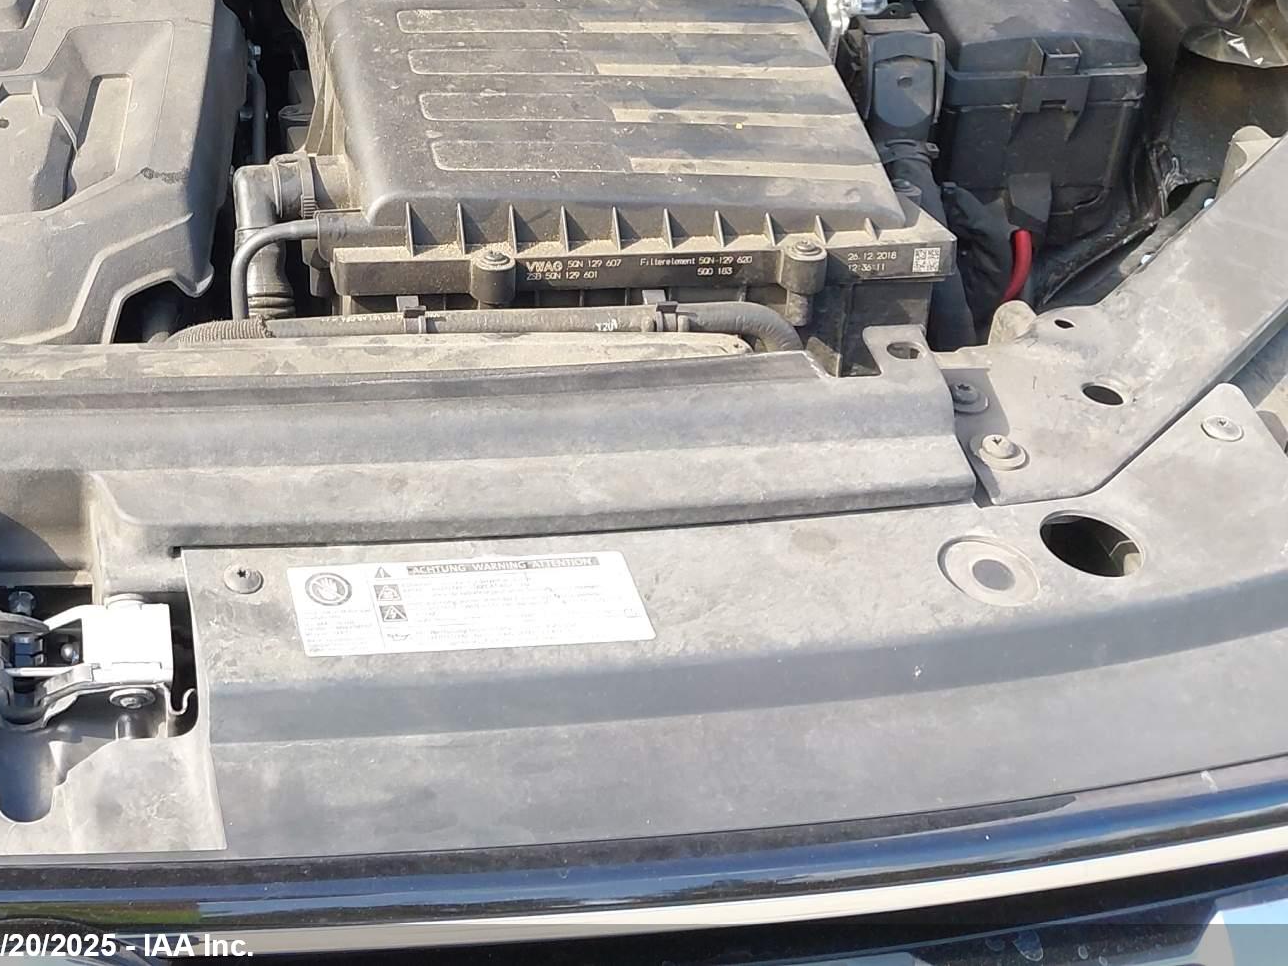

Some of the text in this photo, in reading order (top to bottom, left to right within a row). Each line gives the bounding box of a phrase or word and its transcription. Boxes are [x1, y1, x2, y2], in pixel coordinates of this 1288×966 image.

[525, 260, 563, 273] VWAG
[588, 258, 603, 268] 129
[605, 258, 622, 267] 607
[565, 271, 581, 280] 129
[583, 270, 598, 279] 601
[412, 556, 594, 575] ACHTUNG WARNING ATTENTION
